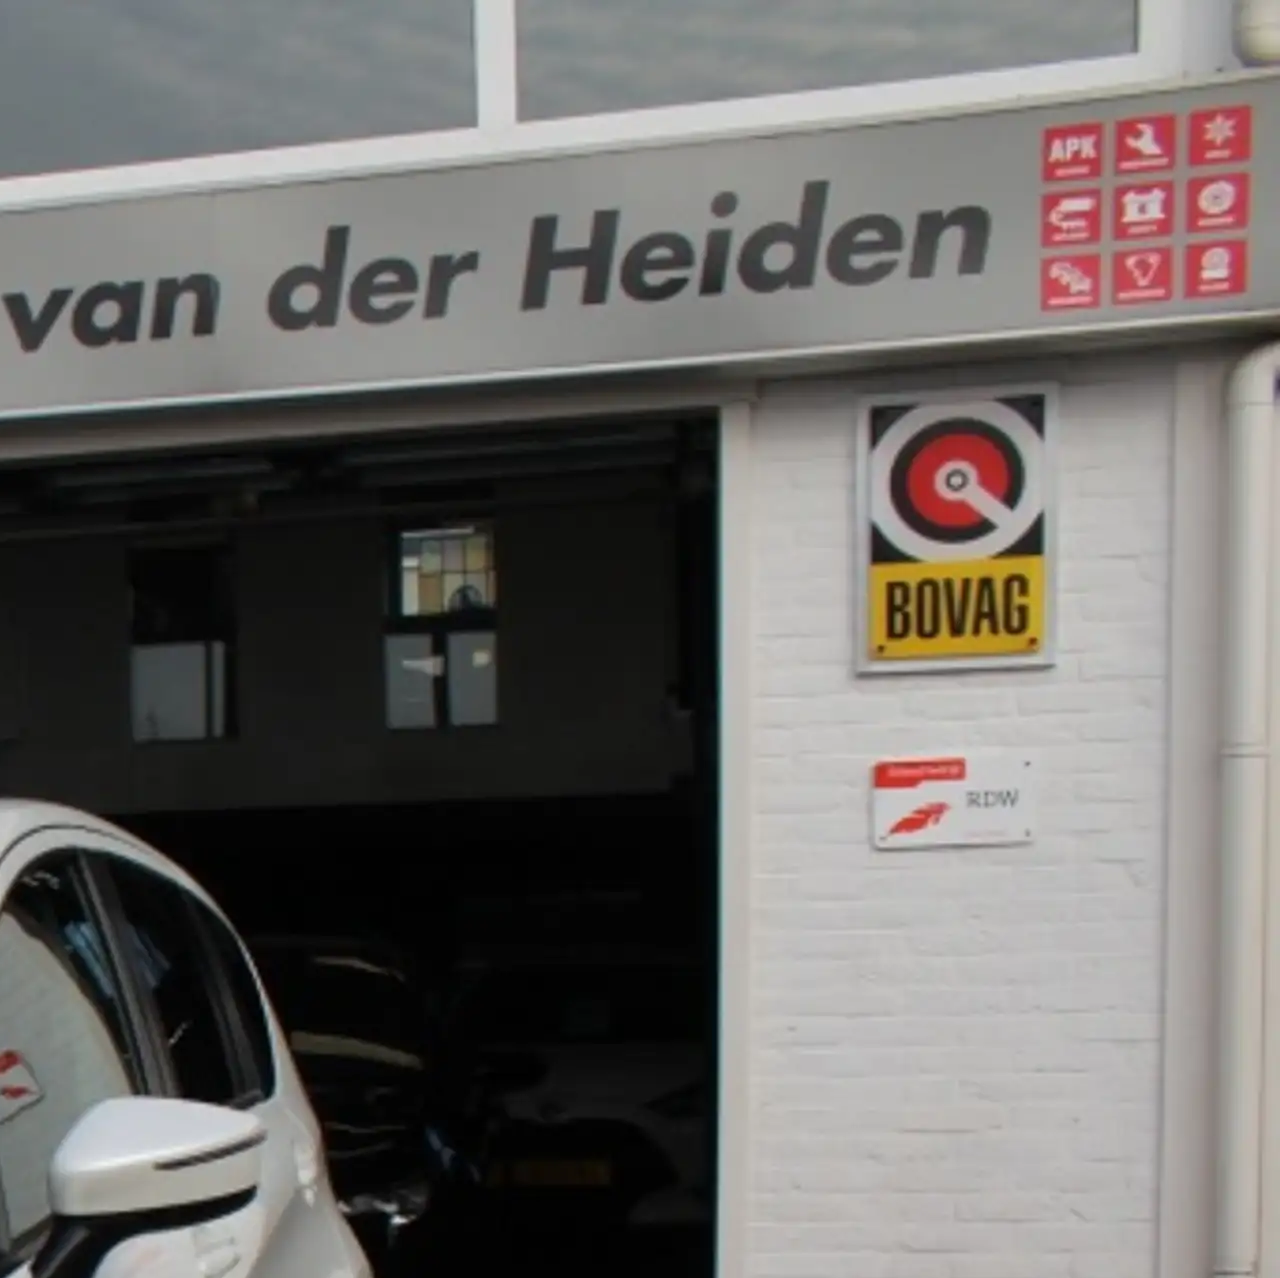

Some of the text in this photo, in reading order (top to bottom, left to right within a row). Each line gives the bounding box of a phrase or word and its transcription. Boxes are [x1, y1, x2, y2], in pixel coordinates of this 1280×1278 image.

[1048, 134, 1097, 163] APK
[2, 266, 221, 353] van
[265, 224, 480, 332] der
[519, 180, 992, 313] Heiden
[885, 573, 1030, 641] BOVAG
[965, 788, 1019, 808] RDW
